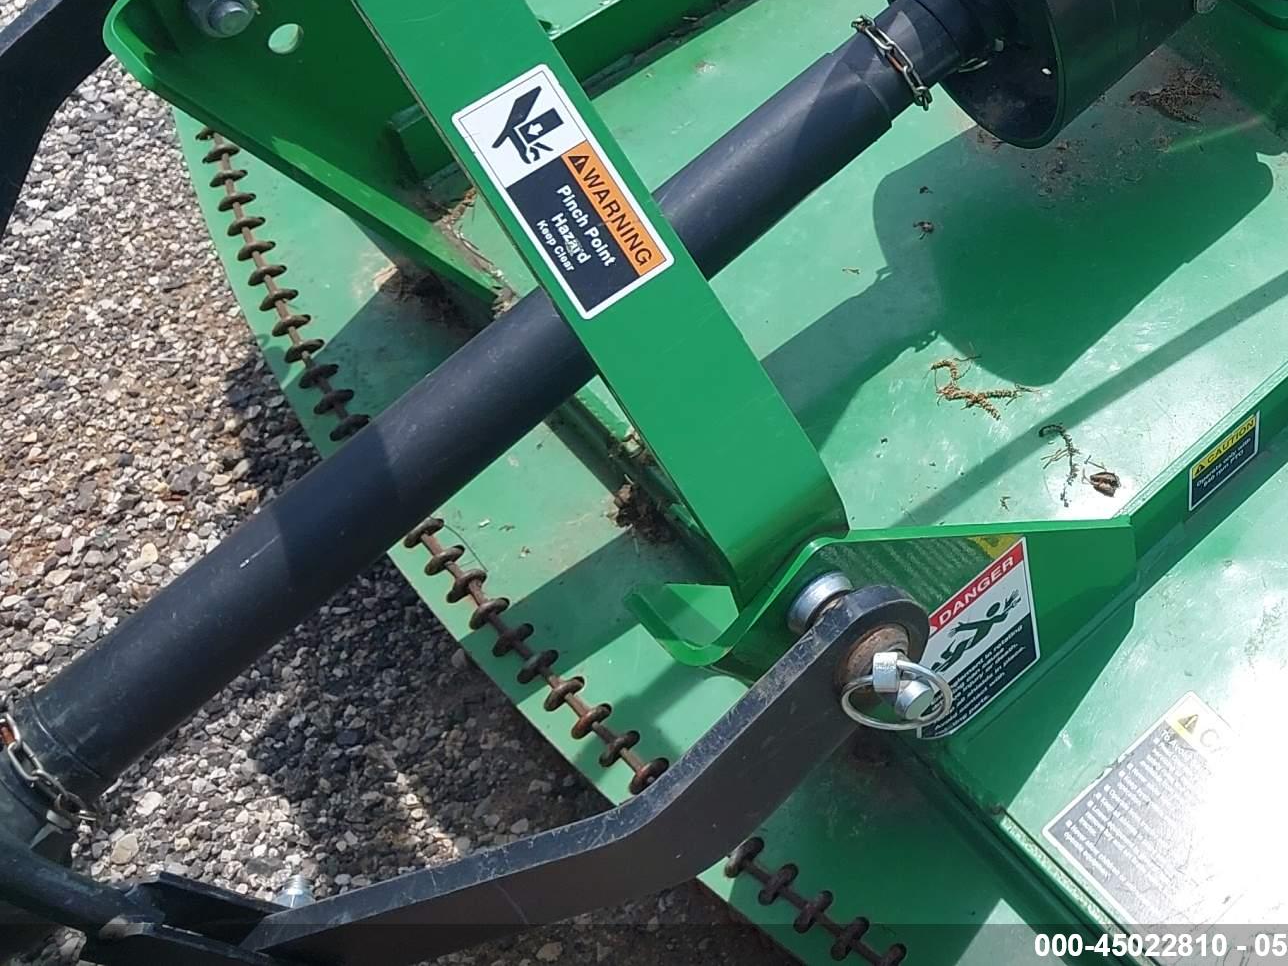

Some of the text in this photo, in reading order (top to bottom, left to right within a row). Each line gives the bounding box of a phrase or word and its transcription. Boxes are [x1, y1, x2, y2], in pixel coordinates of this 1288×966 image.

[549, 211, 591, 264] Hazard
[555, 183, 617, 267] Pinch Point
[580, 167, 654, 267] WARNING
[534, 219, 576, 273] Keep Clear
[1207, 419, 1253, 464] CAUTION
[938, 554, 1013, 627] DANGER
[993, 623, 1022, 653] rotating
